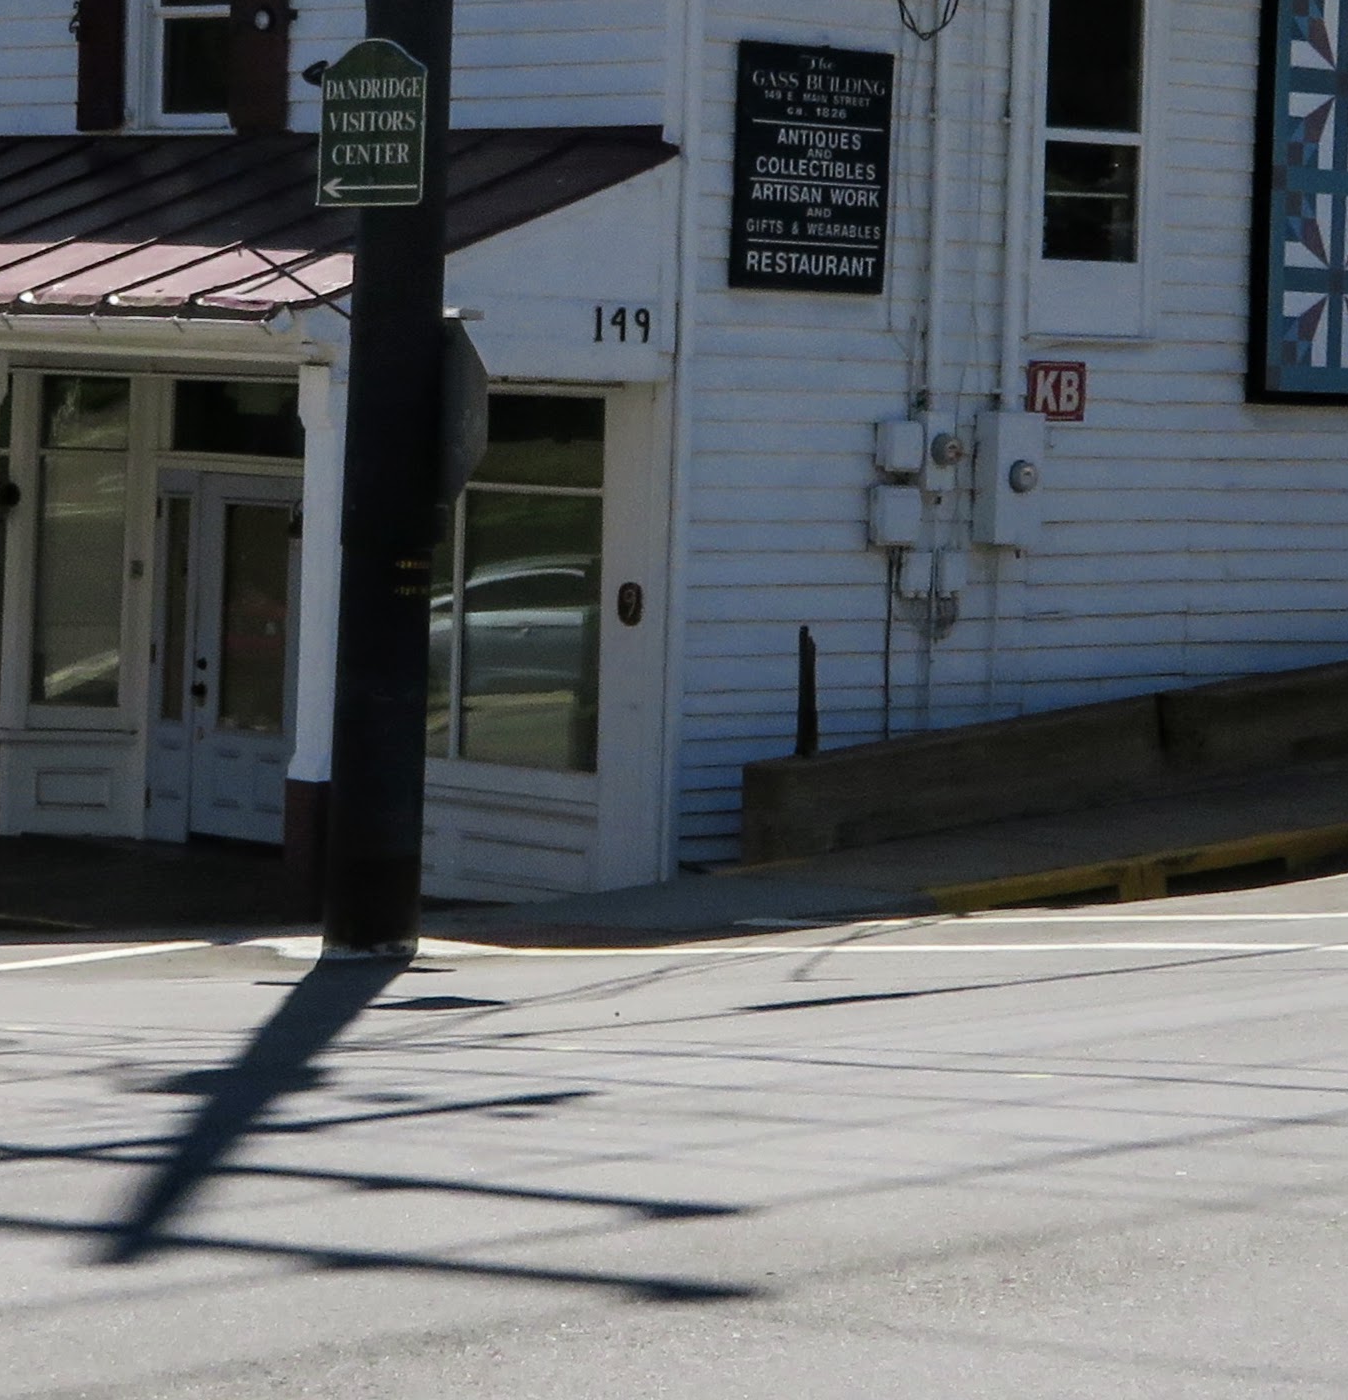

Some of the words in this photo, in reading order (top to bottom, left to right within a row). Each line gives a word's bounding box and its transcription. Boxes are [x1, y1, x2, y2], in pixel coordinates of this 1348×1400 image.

[326, 76, 422, 100] DANDRIDGE
[753, 70, 799, 89] GASS
[806, 74, 886, 96] BUILDING
[803, 93, 828, 103] MAIN
[833, 95, 871, 107] STREET
[330, 110, 416, 132] VISITORS
[816, 107, 847, 119] 1826
[777, 128, 862, 150] ANTIQUES
[332, 143, 410, 165] CENTER
[806, 148, 832, 159] AND
[756, 156, 876, 180] COLLECTIBLES
[751, 183, 822, 203] ARTISAN
[830, 188, 880, 208] WORK
[806, 207, 832, 218] AND
[746, 218, 784, 234] GIFTS
[791, 221, 799, 235] &
[806, 222, 881, 240] WEARABLES
[746, 250, 876, 277] RESTAURANT
[594, 306, 650, 343] 149
[1034, 370, 1079, 412] KB
